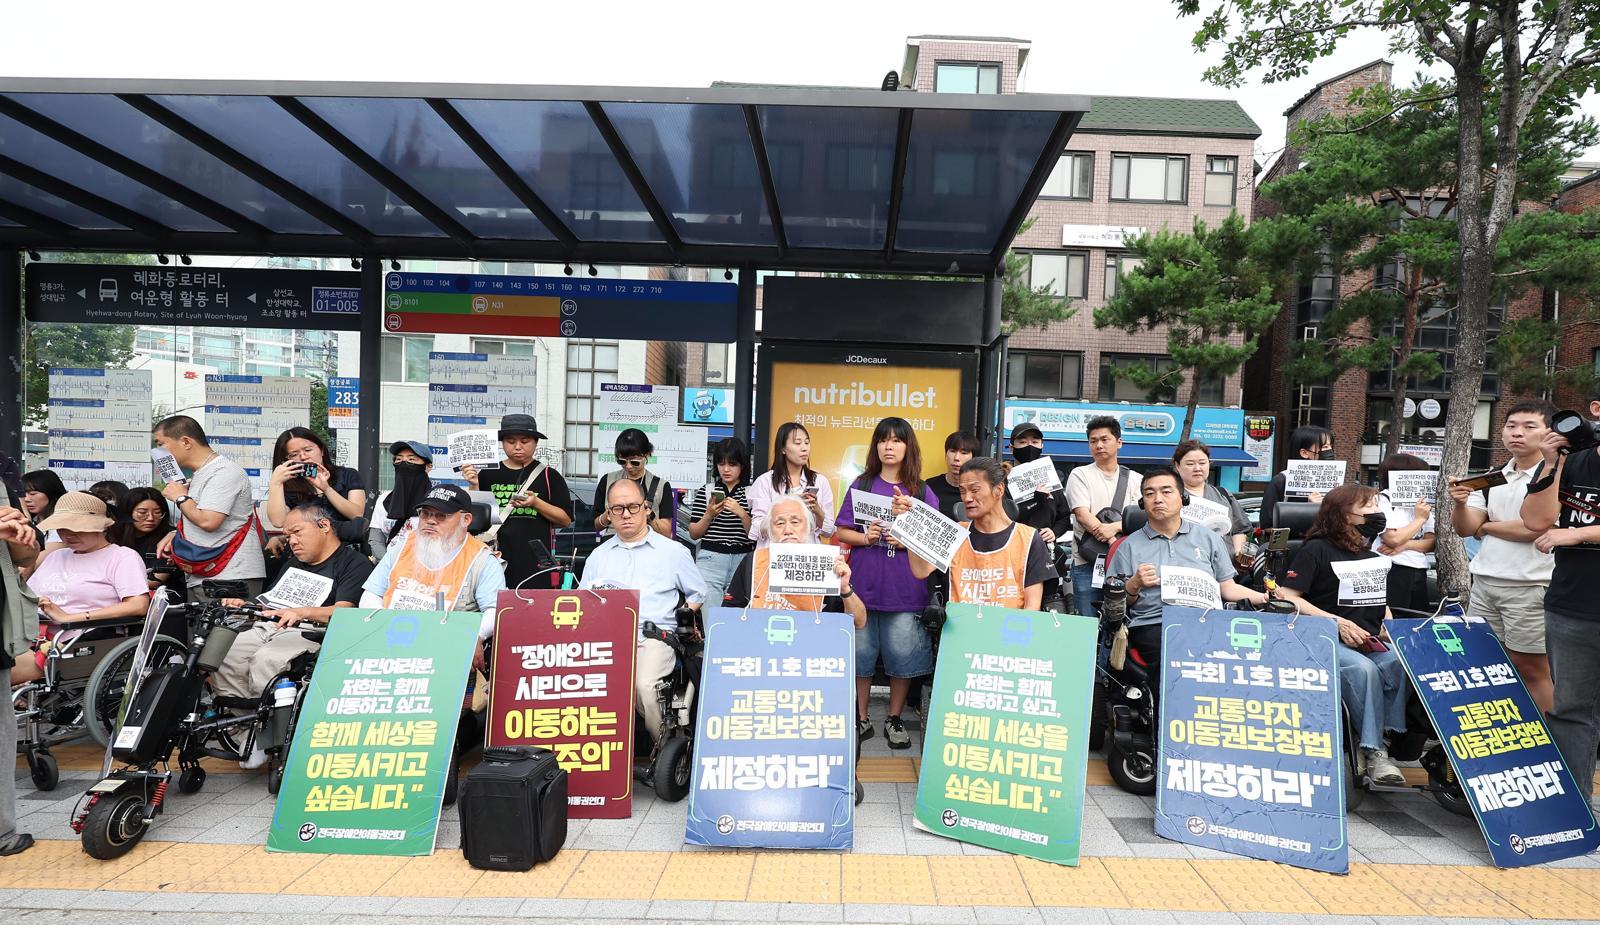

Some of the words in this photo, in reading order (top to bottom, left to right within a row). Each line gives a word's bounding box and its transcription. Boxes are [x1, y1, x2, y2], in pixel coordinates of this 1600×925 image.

[131, 290, 173, 307] 여운형
[180, 291, 209, 308] 활동
[216, 291, 228, 308] 터
[406, 279, 417, 287] 100
[633, 286, 644, 294] 272
[86, 309, 132, 319] Hyehwa-dong
[135, 311, 159, 321] Rotary,
[177, 312, 184, 320] of
[186, 313, 203, 322] Lyuh
[205, 313, 248, 322] Woon-hyung
[316, 300, 359, 312] 01-005
[845, 355, 888, 365] JCDecaux
[335, 391, 360, 405] 283
[1040, 412, 1081, 424] DESIGN
[904, 514, 925, 532] 이제는
[923, 528, 951, 550] 교통약자
[914, 503, 942, 524] 교통약자의
[940, 520, 959, 535] 이동은
[923, 518, 941, 534] 아니라
[939, 528, 956, 543] 권리!
[896, 518, 916, 536] 이동권
[915, 532, 950, 560] 보장법으로!
[771, 562, 797, 570] 교통약자
[799, 563, 818, 571] 이동권
[777, 555, 793, 563] 22대
[794, 555, 808, 563] 국회
[820, 556, 834, 564] 법안
[785, 570, 826, 582] 제정하라
[1168, 574, 1185, 582] 22대
[1178, 587, 1215, 603] 제정하라
[345, 657, 435, 676] "시민여러분,
[511, 642, 613, 670] "장애인도
[712, 656, 763, 678] "국회
[766, 656, 808, 678] 1호
[806, 656, 847, 679] 법안
[964, 653, 1057, 678] "시민여러분,
[340, 678, 393, 697] 저희는
[393, 678, 429, 697] 함께
[515, 673, 608, 701] 시민으로
[965, 673, 1014, 695] 저희는
[1017, 677, 1053, 698] 함께
[1170, 660, 1226, 685] "국회
[1231, 664, 1275, 688] 1호
[1278, 666, 1331, 692] 법안
[1418, 670, 1463, 693] "국회
[1458, 667, 1491, 690] 1호
[1483, 662, 1519, 686] 법안
[326, 696, 395, 716] 이동하고
[730, 689, 824, 714] 교통약자
[953, 690, 1018, 714] 이동하고
[1022, 697, 1062, 719] 싶고,
[1193, 695, 1303, 728] 교통약자
[1451, 697, 1524, 732] 교통약자
[309, 721, 362, 748] 함께
[363, 720, 438, 748] 세상을
[505, 706, 617, 740] 이동하는
[706, 714, 847, 740] 이동권보장법
[943, 711, 991, 741] 함께
[993, 718, 1069, 752] 세상을
[1168, 719, 1333, 759] 이동권보장법
[1449, 720, 1553, 761] 이동권보장법
[306, 751, 428, 780] 이동시키고
[530, 741, 624, 774] 주의"
[942, 742, 1063, 784] 이동시키고
[700, 754, 845, 791] 제정하라"
[1165, 758, 1332, 808] 제정하라"
[304, 783, 424, 812] 싶습니다."
[944, 773, 1062, 814] 싶습니다."
[1466, 760, 1564, 814] 제정하라"
[318, 827, 407, 841] 전국장애인이동권연대
[736, 819, 826, 833] 전국장애인이동권연대
[960, 816, 1049, 847] 전국장애인이동권연대
[1208, 823, 1312, 853] 전국장애인이동권연대
[1521, 829, 1585, 850] 전국장애인이동권연대
